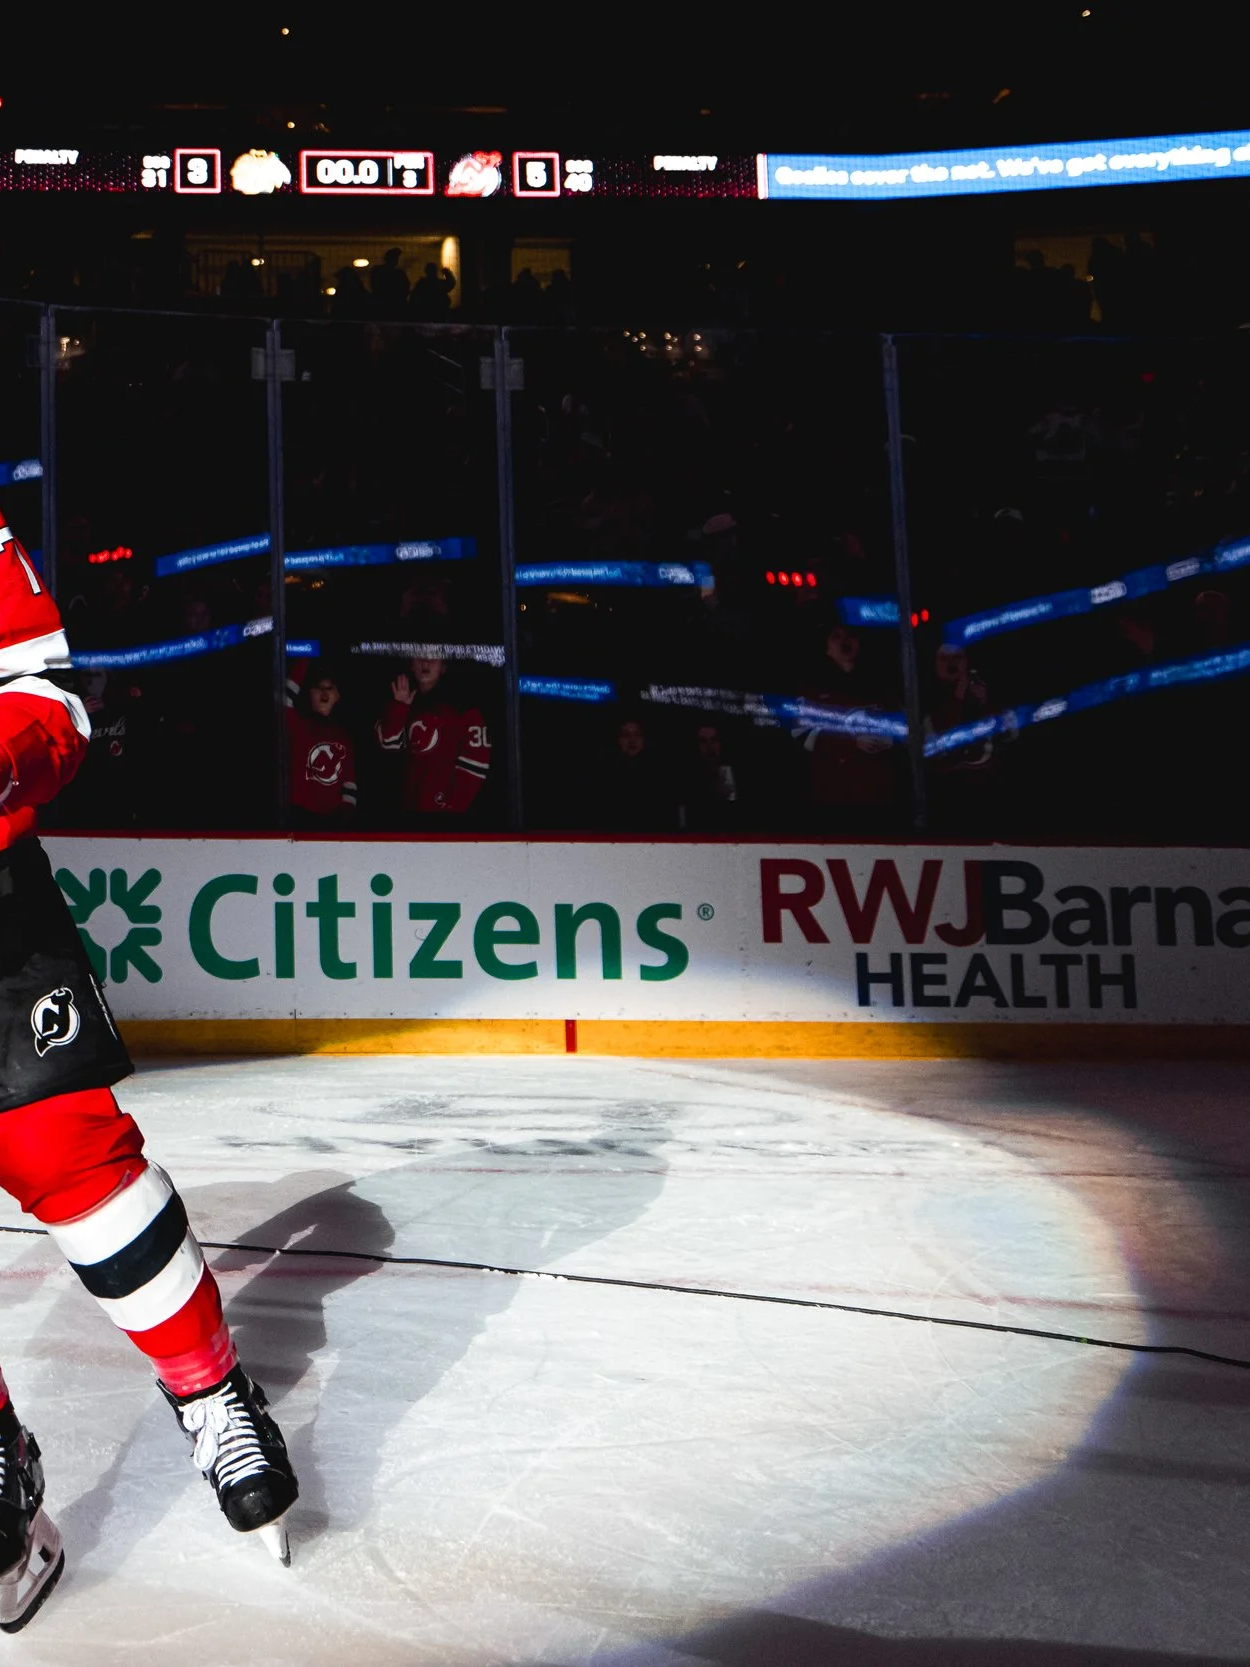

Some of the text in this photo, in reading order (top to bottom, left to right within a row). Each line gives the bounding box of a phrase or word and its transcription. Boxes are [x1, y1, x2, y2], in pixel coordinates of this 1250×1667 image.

[15, 149, 79, 165] PENALTY
[653, 155, 718, 171] PENALTY
[187, 158, 208, 184] 3
[526, 161, 547, 188] 5
[909, 163, 949, 183] the
[855, 951, 1139, 1010] HEALTH
